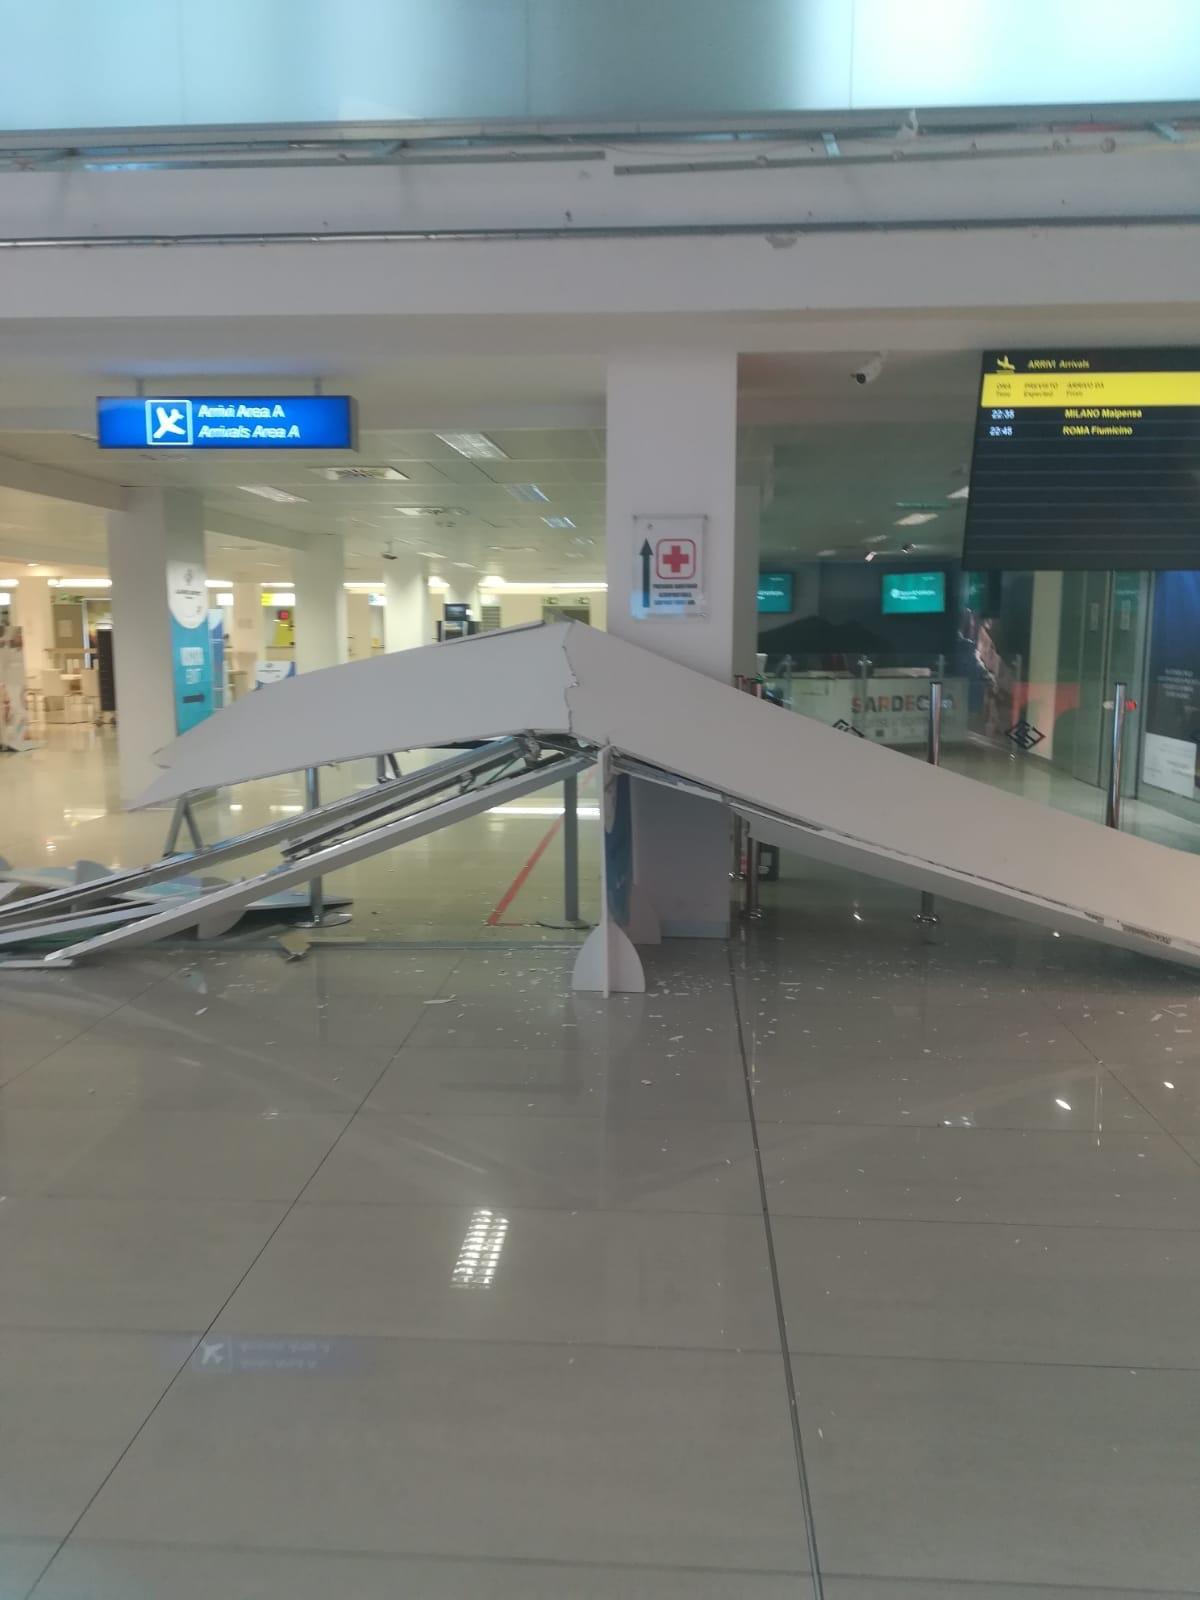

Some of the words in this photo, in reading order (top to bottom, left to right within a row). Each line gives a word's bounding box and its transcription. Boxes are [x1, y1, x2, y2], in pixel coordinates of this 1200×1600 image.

[1028, 360, 1056, 368] ARRIVI
[1059, 360, 1090, 368] Arrivals
[198, 405, 235, 417] Arrivi
[236, 405, 271, 417] Area
[272, 405, 285, 417] A
[1065, 409, 1100, 418] MILANO
[1102, 408, 1142, 419] Malpensa
[198, 425, 251, 438] Arrivals
[252, 425, 286, 438] Area
[287, 425, 300, 438] A
[1063, 426, 1090, 435] ROMA
[1092, 426, 1133, 435] Fiumicino
